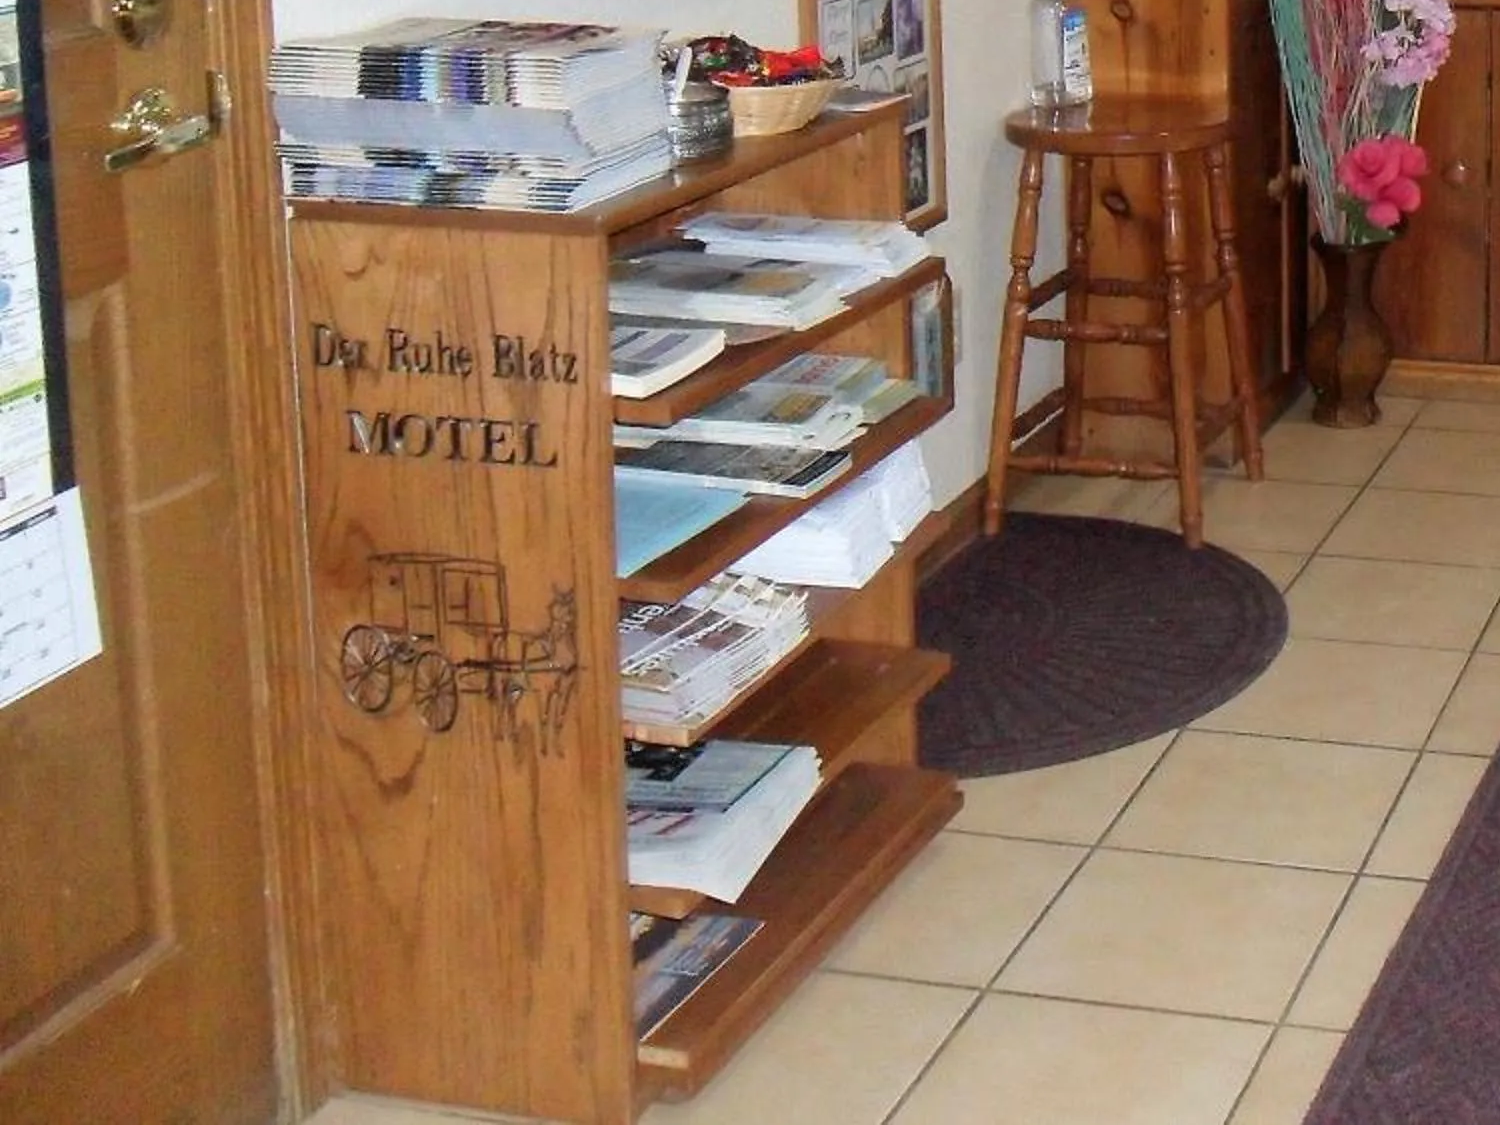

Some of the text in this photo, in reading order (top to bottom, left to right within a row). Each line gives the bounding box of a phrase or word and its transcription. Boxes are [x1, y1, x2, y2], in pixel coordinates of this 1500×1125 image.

[311, 323, 578, 384] Der Ruhe Blatz
[346, 410, 558, 468] MOTEL
